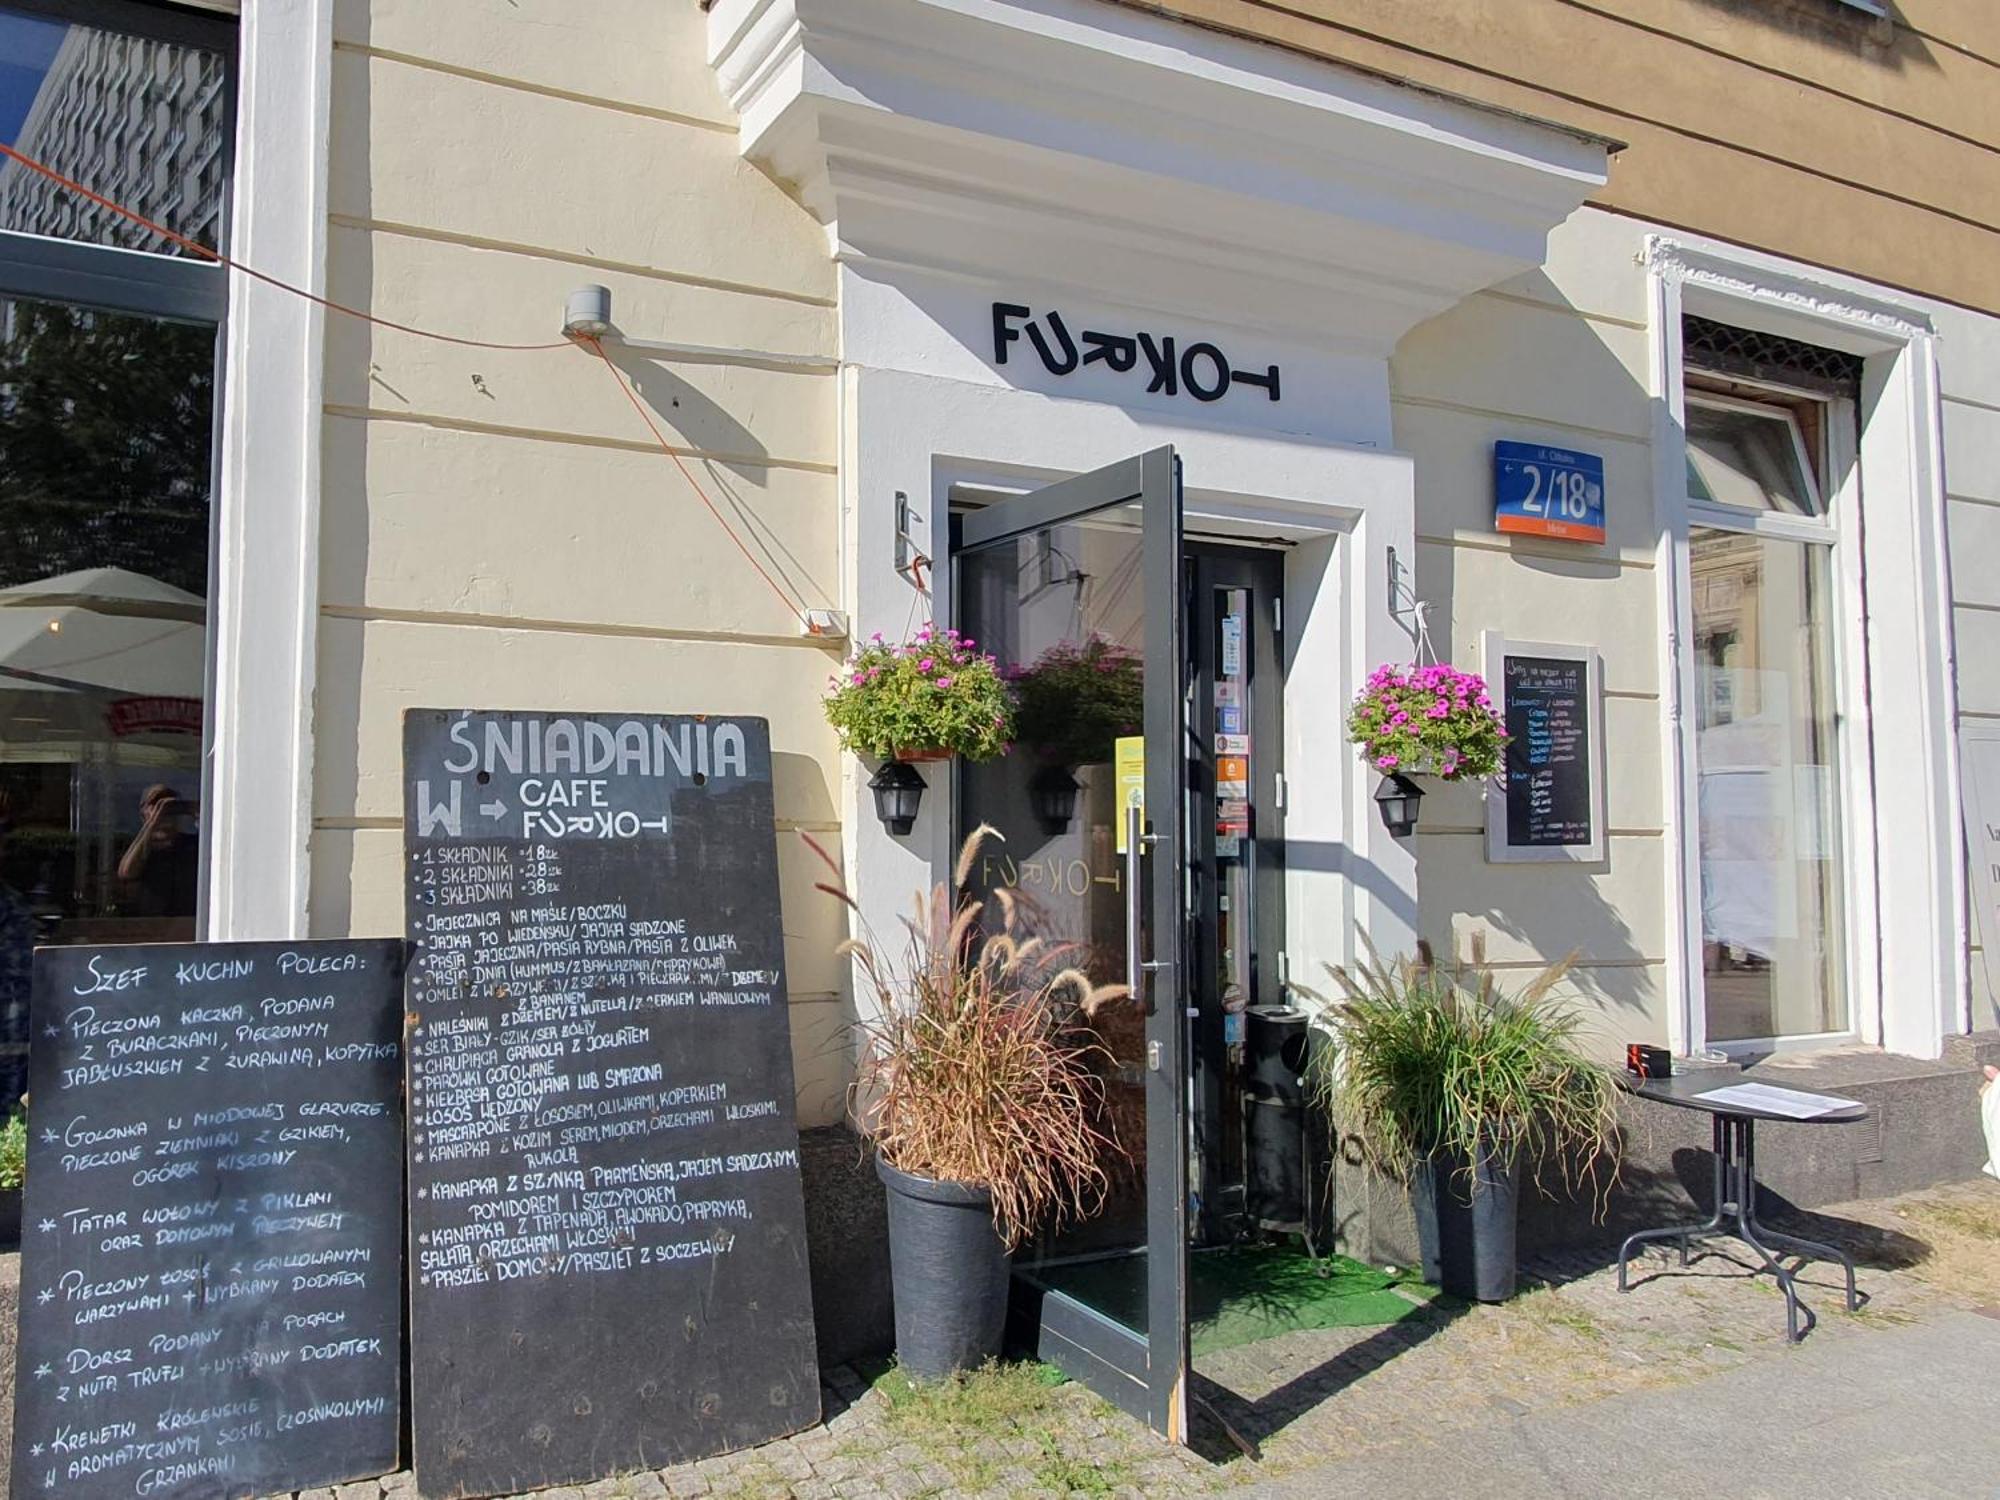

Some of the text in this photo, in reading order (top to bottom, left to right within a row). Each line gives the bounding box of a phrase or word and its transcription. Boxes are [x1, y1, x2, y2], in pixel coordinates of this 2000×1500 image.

[992, 302, 1280, 401] FURKOT
[1522, 465, 1586, 518] 2/18
[443, 711, 747, 777] ŚNIADANIA
[417, 780, 462, 837] W
[519, 779, 608, 807] CAFE
[523, 809, 668, 839] FURKOT
[423, 848, 435, 864] 1
[438, 846, 508, 865] SKŁADNIK
[423, 869, 436, 885] 2
[441, 864, 513, 885] SKŁADNIKI
[983, 853, 1120, 896] FURKOT
[425, 888, 436, 905] 3
[441, 883, 513, 906] SKŁADNIKI
[426, 911, 500, 932] JAJECZNICA
[511, 908, 526, 924] NA
[429, 934, 471, 949] JAJKA
[479, 931, 498, 947] PO
[581, 921, 623, 938] JAJKA
[629, 919, 686, 936] SADZONE
[428, 951, 466, 969] PASTA
[681, 936, 690, 953] Z
[693, 934, 737, 953] OLIWEK
[176, 960, 253, 985] KUCHNI
[472, 966, 507, 984] DNIA
[470, 985, 478, 997] Z
[531, 991, 586, 1010] BANANEM
[65, 1006, 161, 1039] PIECZONA
[261, 995, 334, 1017] PODANA
[428, 1011, 489, 1037] NALEŚNIKI
[700, 991, 771, 1006] WANILIOWYM
[79, 1045, 95, 1060] Z
[236, 1022, 328, 1042] PIECZONYM
[424, 1038, 449, 1056] SER
[506, 1041, 564, 1062] GRANOLA
[571, 1039, 580, 1053] Z
[586, 1026, 650, 1052] JOGURTEM
[61, 1059, 183, 1089] JABŁUSZKIEM
[195, 1056, 211, 1072] Z
[325, 1042, 398, 1062] KOPYTKA
[486, 1060, 555, 1084] GOTOWANE
[426, 1087, 490, 1109] KIEŁBASA
[496, 1074, 570, 1100] GOTOWANA
[578, 1071, 600, 1090] LUB
[65, 1115, 148, 1148] GOLONKA
[168, 1117, 182, 1130] W
[194, 1103, 284, 1127] MIODOWEJ
[425, 1095, 543, 1126] ŁOSOŚ WĘDZONY
[428, 1116, 511, 1145] MASCARPONE
[519, 1115, 528, 1130] Z
[660, 1082, 727, 1106] KOPERKIEM
[61, 1145, 142, 1173] PIECZONE
[155, 1131, 239, 1155] ZIEMNIAKI
[429, 1141, 490, 1163] KANAPKA
[513, 1131, 552, 1150] KOZIM
[132, 1150, 297, 1186] OGÓREK KISZONY
[432, 1177, 499, 1200] KANAPKA
[507, 1175, 518, 1192] Z
[469, 1185, 676, 1222] POMIDOREM I SZCZYPIOREM
[62, 1208, 127, 1235] TATAR
[142, 1201, 219, 1224] WOŁOWY
[262, 1192, 332, 1211] PIKLAMI
[101, 1234, 144, 1253] ORAZ
[432, 1220, 505, 1247] KANAPKA
[518, 1218, 528, 1235] Z
[479, 1236, 560, 1261] ORZECHAMI
[640, 1247, 650, 1264] Z
[59, 1270, 149, 1301] PIECZONY
[253, 1248, 371, 1273] GRILLOWANYMI
[75, 1271, 366, 1325] WARZYWAMI WYBRANY DODATEK
[66, 1349, 133, 1375] DORSZ
[149, 1328, 223, 1354] PODANY
[57, 1387, 70, 1402] Z
[128, 1365, 185, 1388] TRUFLI
[300, 1338, 383, 1362] DODATEK
[52, 1422, 137, 1454] KREWETKI
[45, 1467, 56, 1488] W
[68, 1435, 200, 1480] AROMATYCZNYM
[136, 1453, 236, 1496] GRZANKAMI
